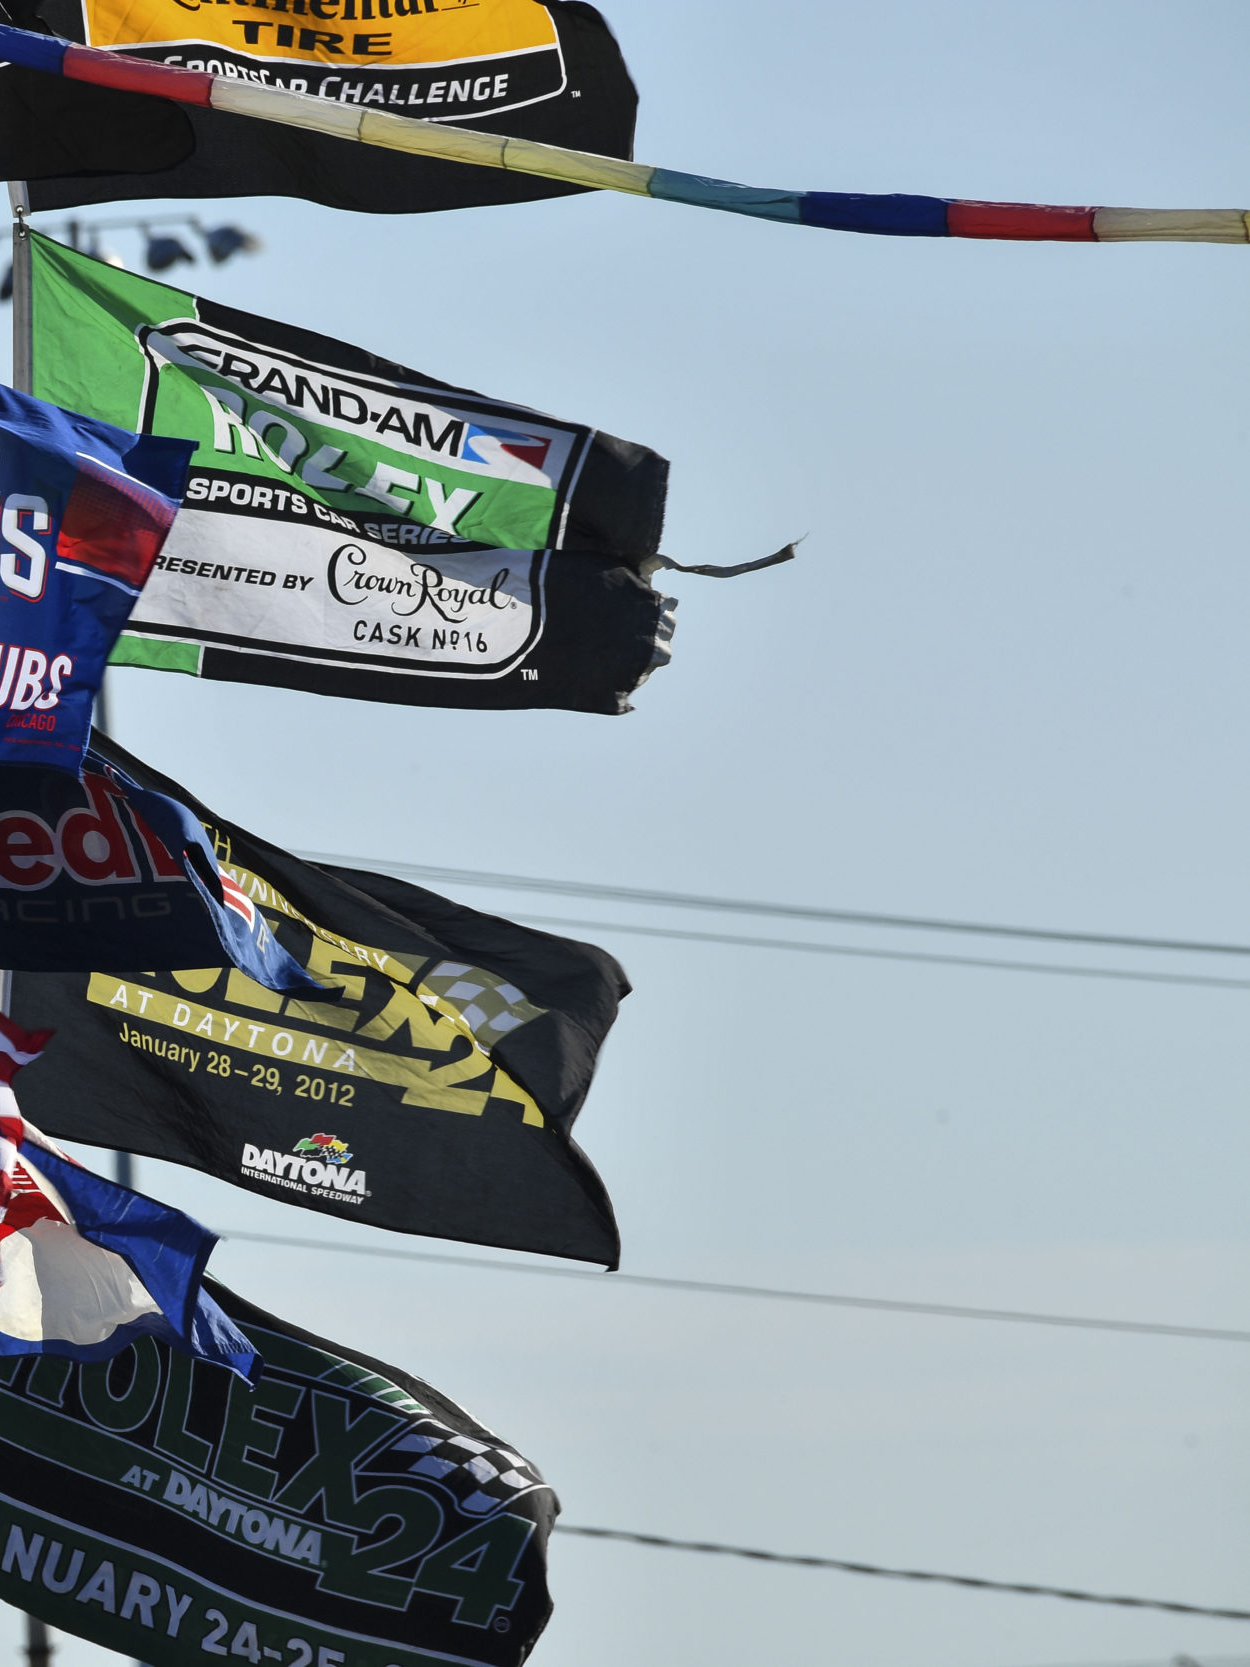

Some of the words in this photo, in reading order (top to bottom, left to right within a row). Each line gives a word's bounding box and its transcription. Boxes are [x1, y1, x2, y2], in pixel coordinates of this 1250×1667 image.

[232, 19, 392, 56] TIRE
[318, 74, 509, 105] CHALLENGE
[186, 477, 308, 514] SPORTS
[315, 503, 362, 535] CAR
[152, 555, 277, 587] RESENTED
[282, 574, 315, 592] BY
[327, 543, 416, 606] Crown
[391, 563, 513, 624] Royal
[353, 619, 422, 648] CASK
[520, 669, 539, 681] TM
[5, 712, 57, 733] CHICAGO
[109, 984, 153, 1014] AT
[172, 1002, 356, 1072] DAYTONA
[119, 1022, 201, 1073] January
[294, 1074, 356, 1107] 2012
[240, 1166, 308, 1193] INTERNATIONAL
[310, 1186, 365, 1205] SPEEDWAY
[241, 1143, 366, 1195] DAYTONA
[119, 1464, 161, 1492] AT
[162, 1469, 322, 1566] DAYTONA
[316, 1484, 536, 1630] 24
